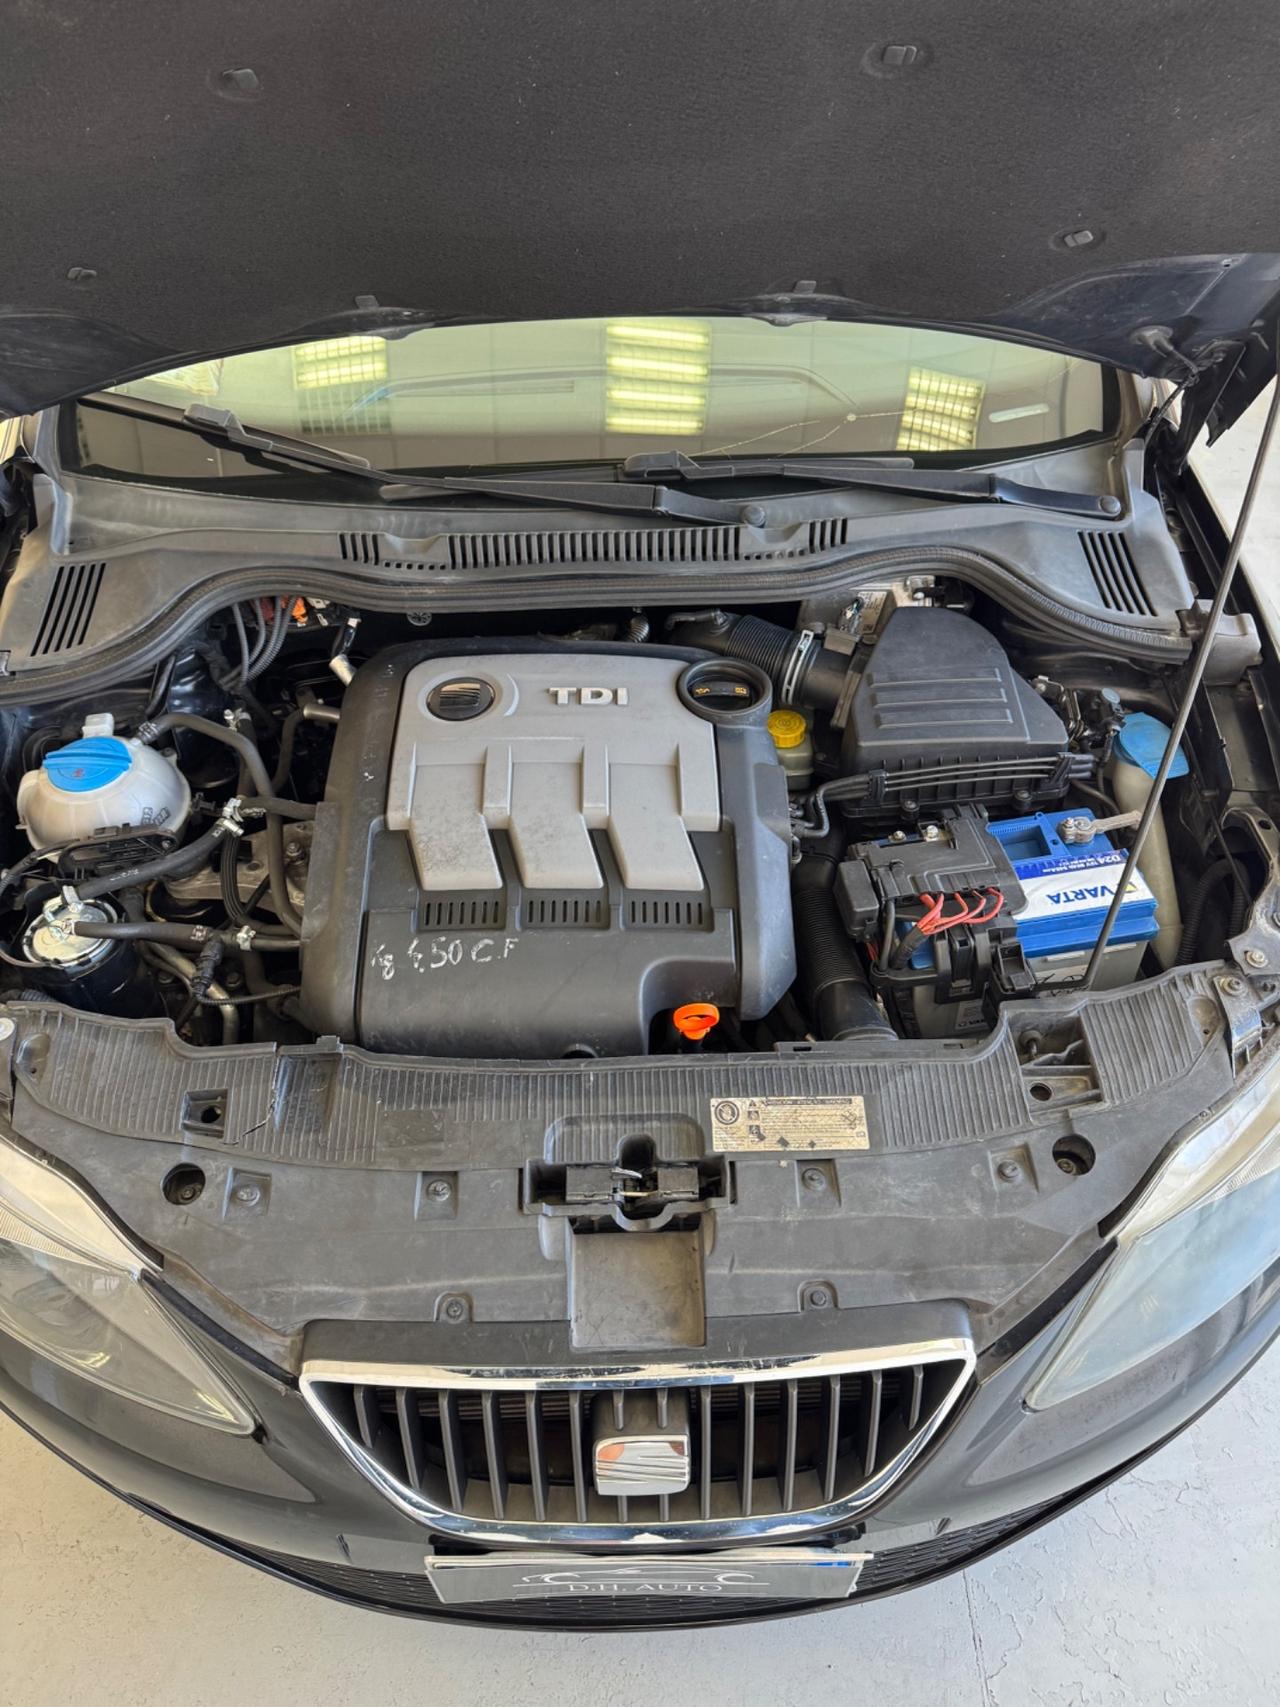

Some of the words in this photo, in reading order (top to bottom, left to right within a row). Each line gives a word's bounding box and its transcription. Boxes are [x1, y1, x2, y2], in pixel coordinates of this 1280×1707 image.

[546, 687, 627, 704] TDI
[1046, 885, 1115, 904] VARTA
[636, 1584, 723, 1592] AUTO
